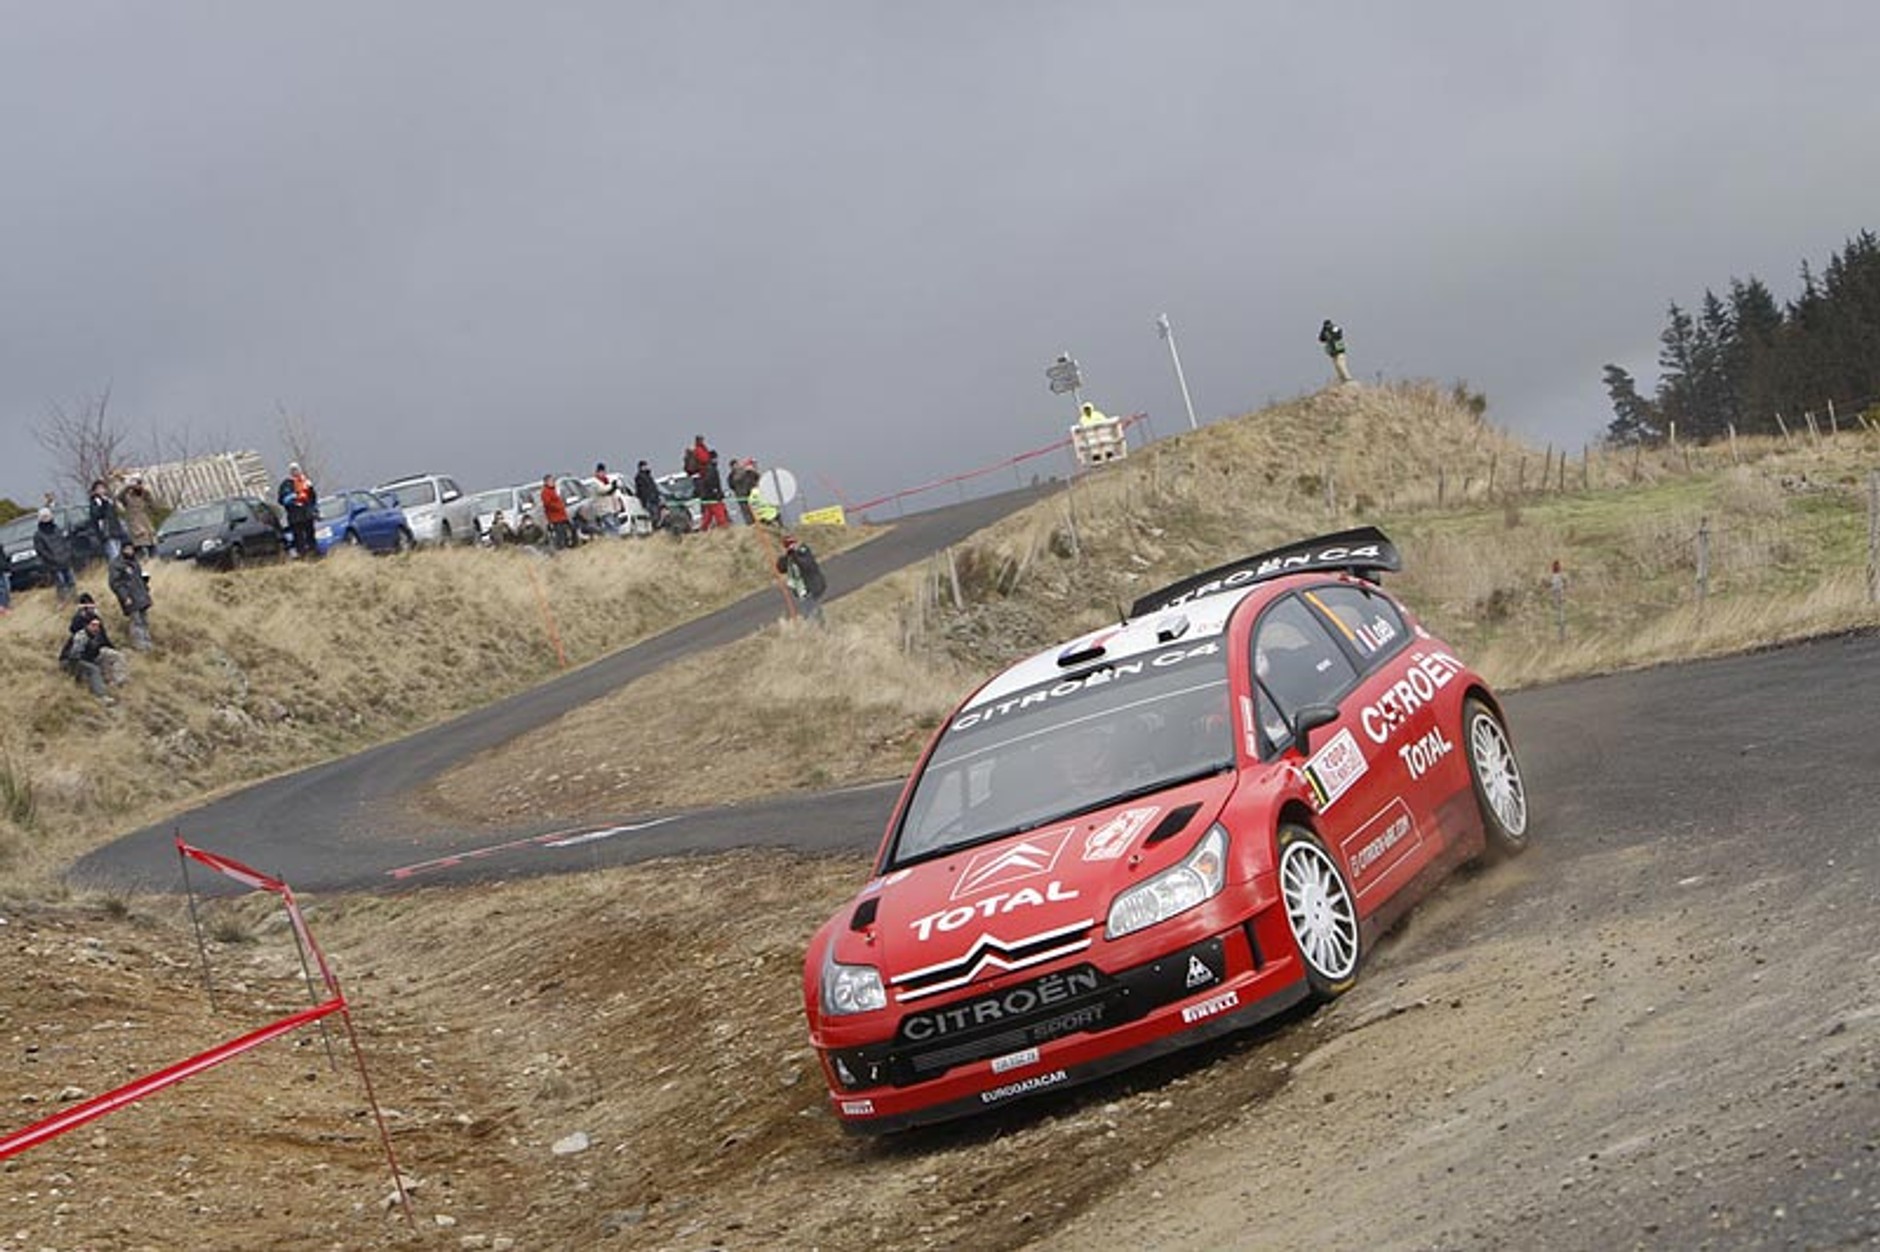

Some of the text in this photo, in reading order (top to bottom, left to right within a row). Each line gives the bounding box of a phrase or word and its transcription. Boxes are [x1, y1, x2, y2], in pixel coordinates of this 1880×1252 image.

[1318, 545, 1380, 560] C4
[951, 641, 1220, 731] CITROËN C4
[1361, 650, 1466, 744] CITROËN
[1398, 725, 1454, 781] TOTAL
[909, 880, 1080, 941] TOTAL
[903, 967, 1099, 1040] CITROËN
[1033, 1003, 1106, 1040] SPORT
